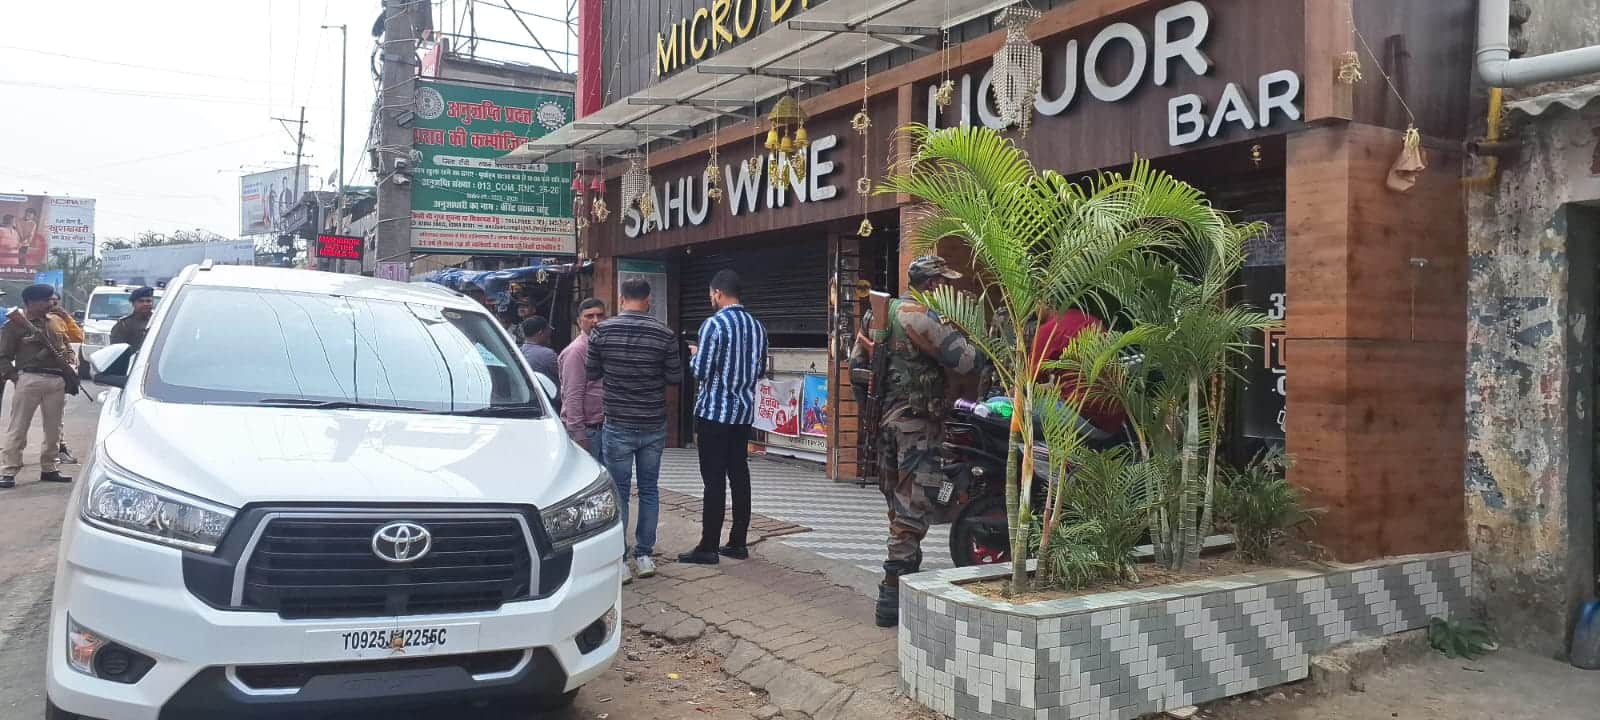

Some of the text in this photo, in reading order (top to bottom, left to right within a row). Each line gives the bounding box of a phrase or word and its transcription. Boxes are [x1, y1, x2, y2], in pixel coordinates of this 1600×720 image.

[656, 0, 757, 76] MICRO
[448, 126, 467, 147] की
[1168, 69, 1301, 147] BAR
[725, 134, 838, 217] WINE
